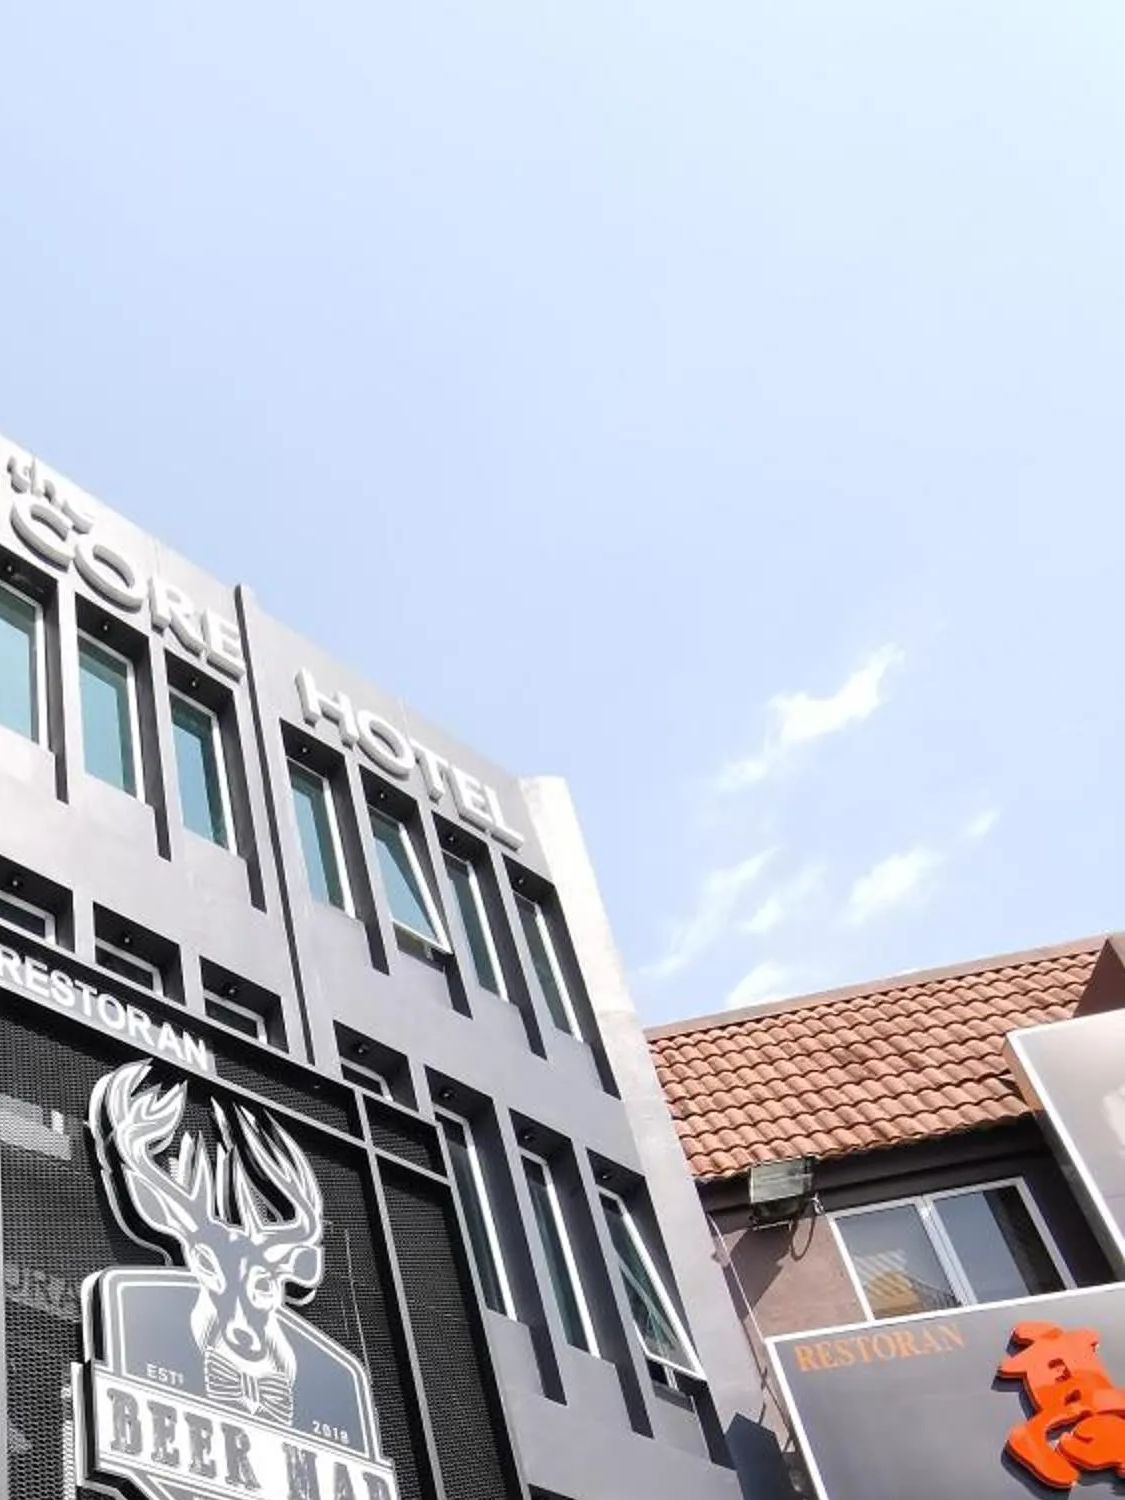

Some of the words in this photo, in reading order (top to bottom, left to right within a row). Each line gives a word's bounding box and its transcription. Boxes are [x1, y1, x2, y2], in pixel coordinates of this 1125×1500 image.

[9, 498, 244, 684] CORE
[294, 667, 524, 851] HOTEL
[793, 1324, 964, 1372] RESTORAN
[106, 1387, 262, 1491] BEER
